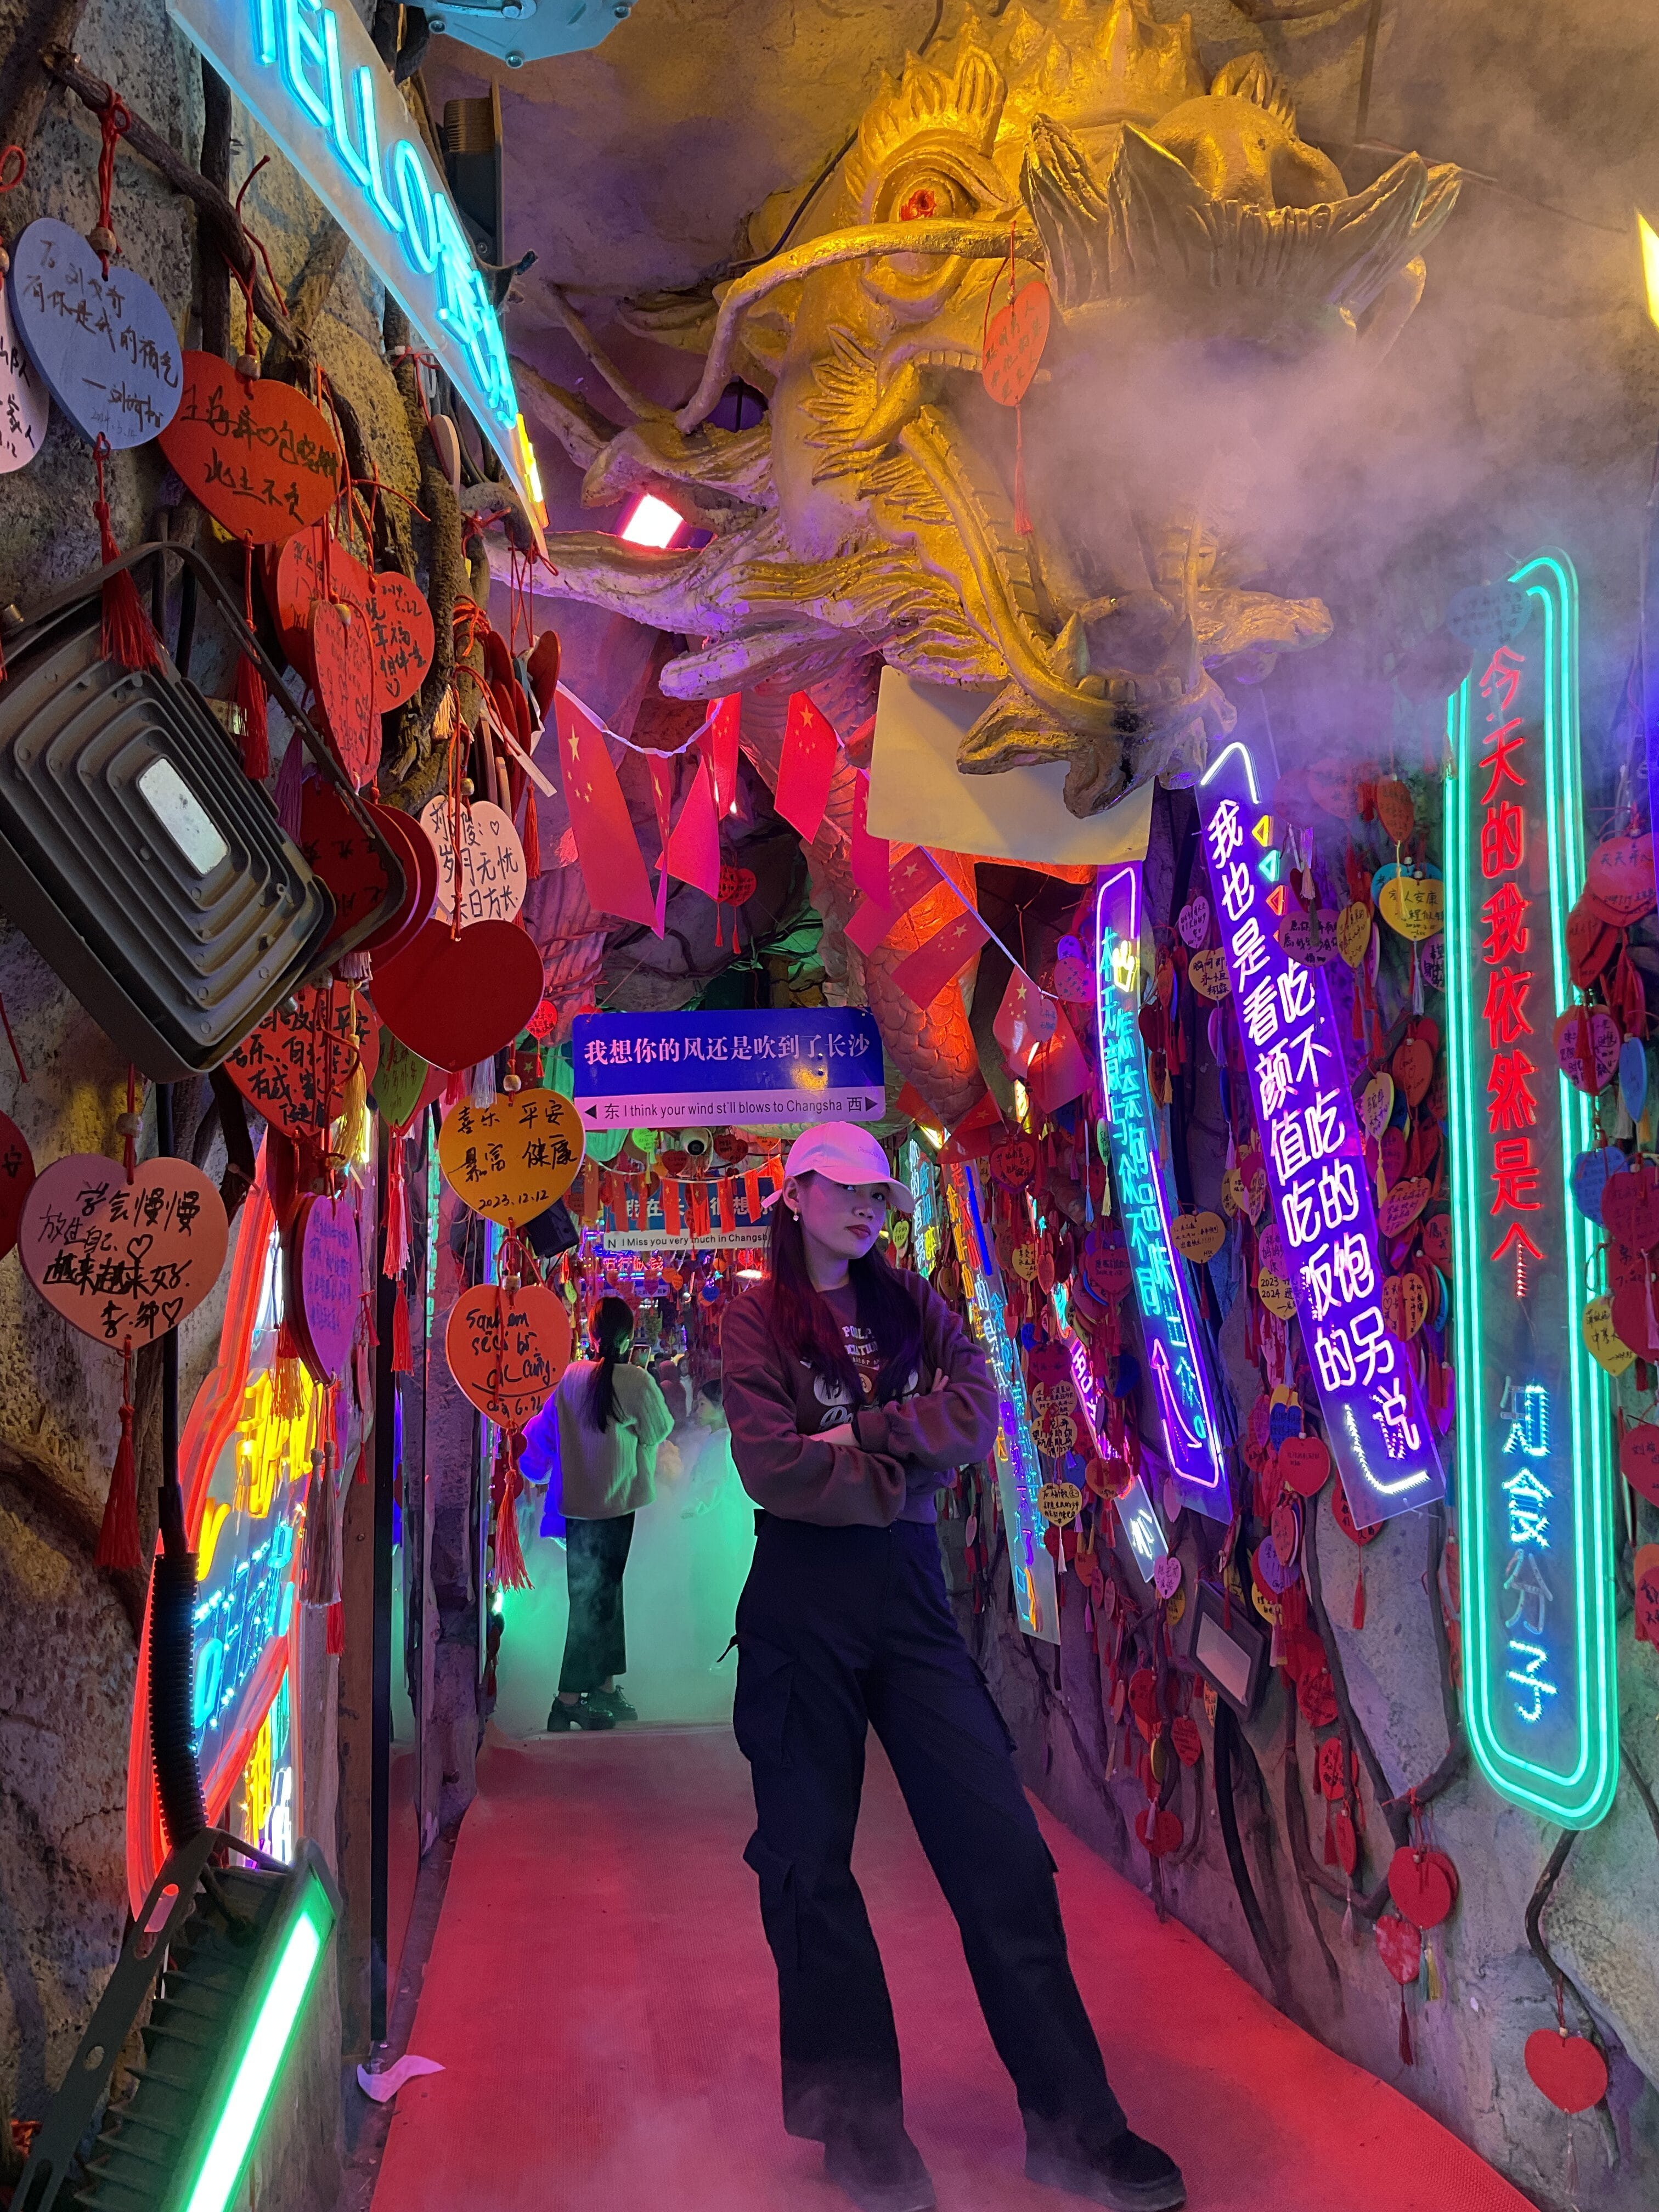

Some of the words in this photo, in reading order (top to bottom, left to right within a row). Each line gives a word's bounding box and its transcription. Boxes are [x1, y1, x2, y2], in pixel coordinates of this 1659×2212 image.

[1479, 644, 1545, 1297] 今天的我依然是个
[583, 1033, 870, 1065] 我想你的风还是吹到了长沙
[604, 1103, 620, 1120] 东
[624, 1104, 627, 1116] I
[630, 1102, 658, 1117] think
[661, 1104, 685, 1121] your
[687, 1101, 714, 1115] wind
[716, 1101, 736, 1114] stll
[739, 1100, 771, 1114] blows
[773, 1101, 785, 1113] to
[787, 1098, 843, 1116] Changsha
[847, 1097, 863, 1112] 西
[1206, 798, 1357, 1392] 我也是看颜值吃饭的
[457, 1105, 500, 1135] 喜乐
[519, 1100, 565, 1130] 平安
[76, 1178, 201, 1237] 学会慢慢
[625, 1197, 774, 1217] 我在想你
[1276, 956, 1422, 1462] 吃不吃的饱另说
[608, 1239, 616, 1248] N
[627, 1237, 648, 1246] Miss
[651, 1238, 667, 1249] you
[669, 1237, 689, 1248] very
[691, 1235, 716, 1244] much
[718, 1234, 726, 1243] in
[1261, 1277, 1279, 1287] 2023
[1261, 1289, 1281, 1299] 2024
